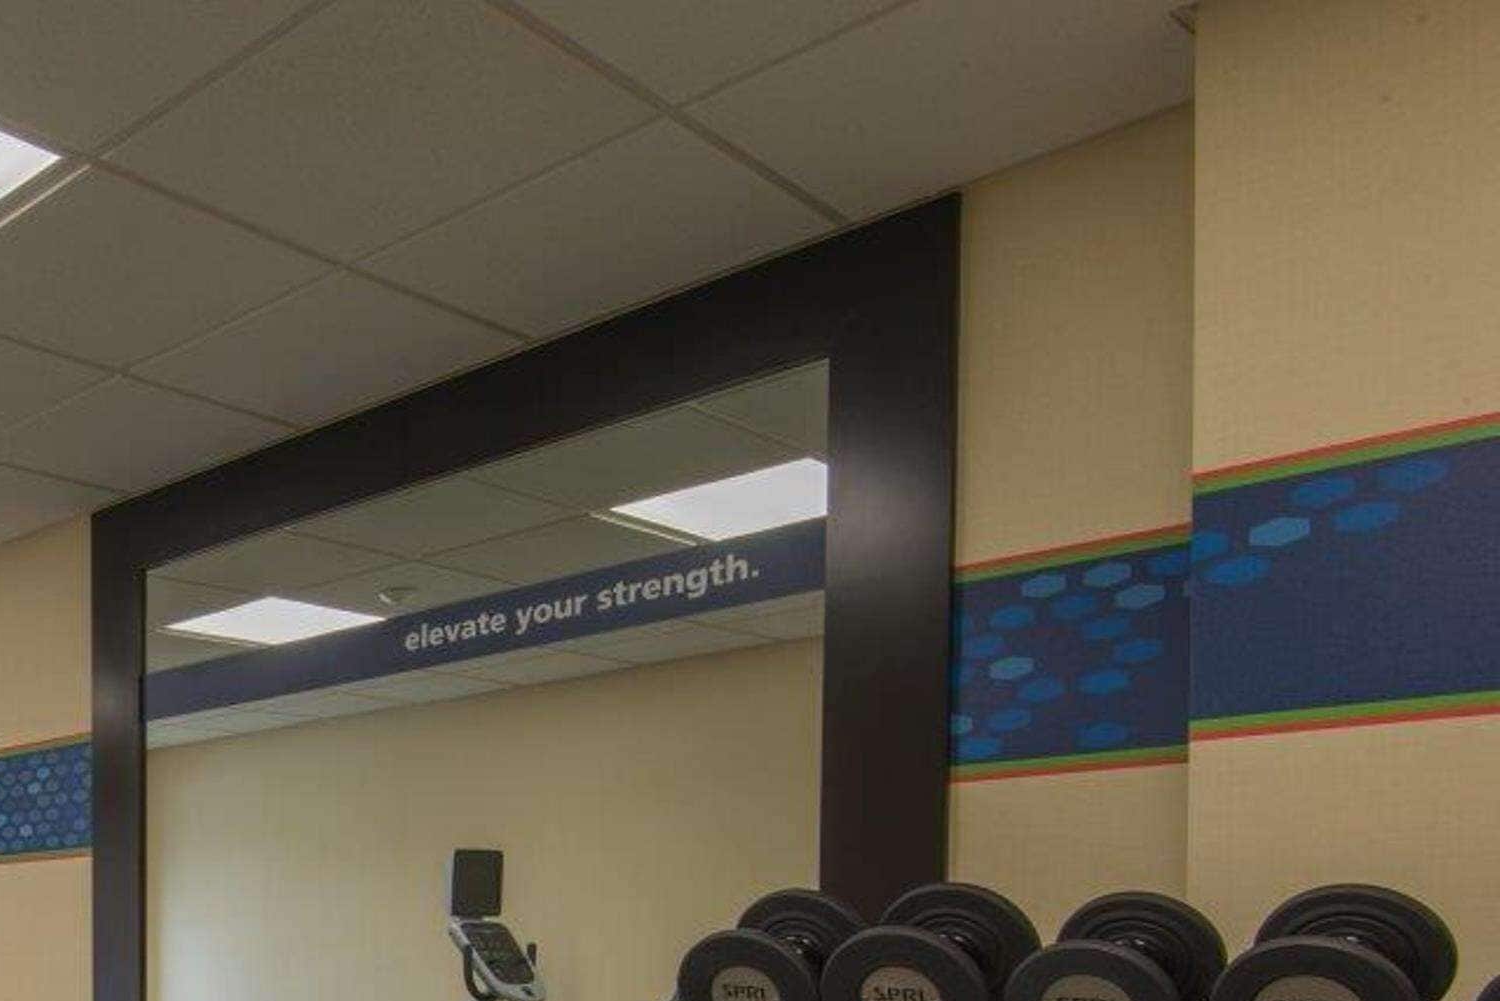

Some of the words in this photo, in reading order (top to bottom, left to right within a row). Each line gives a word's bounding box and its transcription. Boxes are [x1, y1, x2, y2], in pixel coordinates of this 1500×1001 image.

[404, 612, 506, 652] elevate
[514, 594, 588, 636] your
[597, 555, 759, 610] strength.
